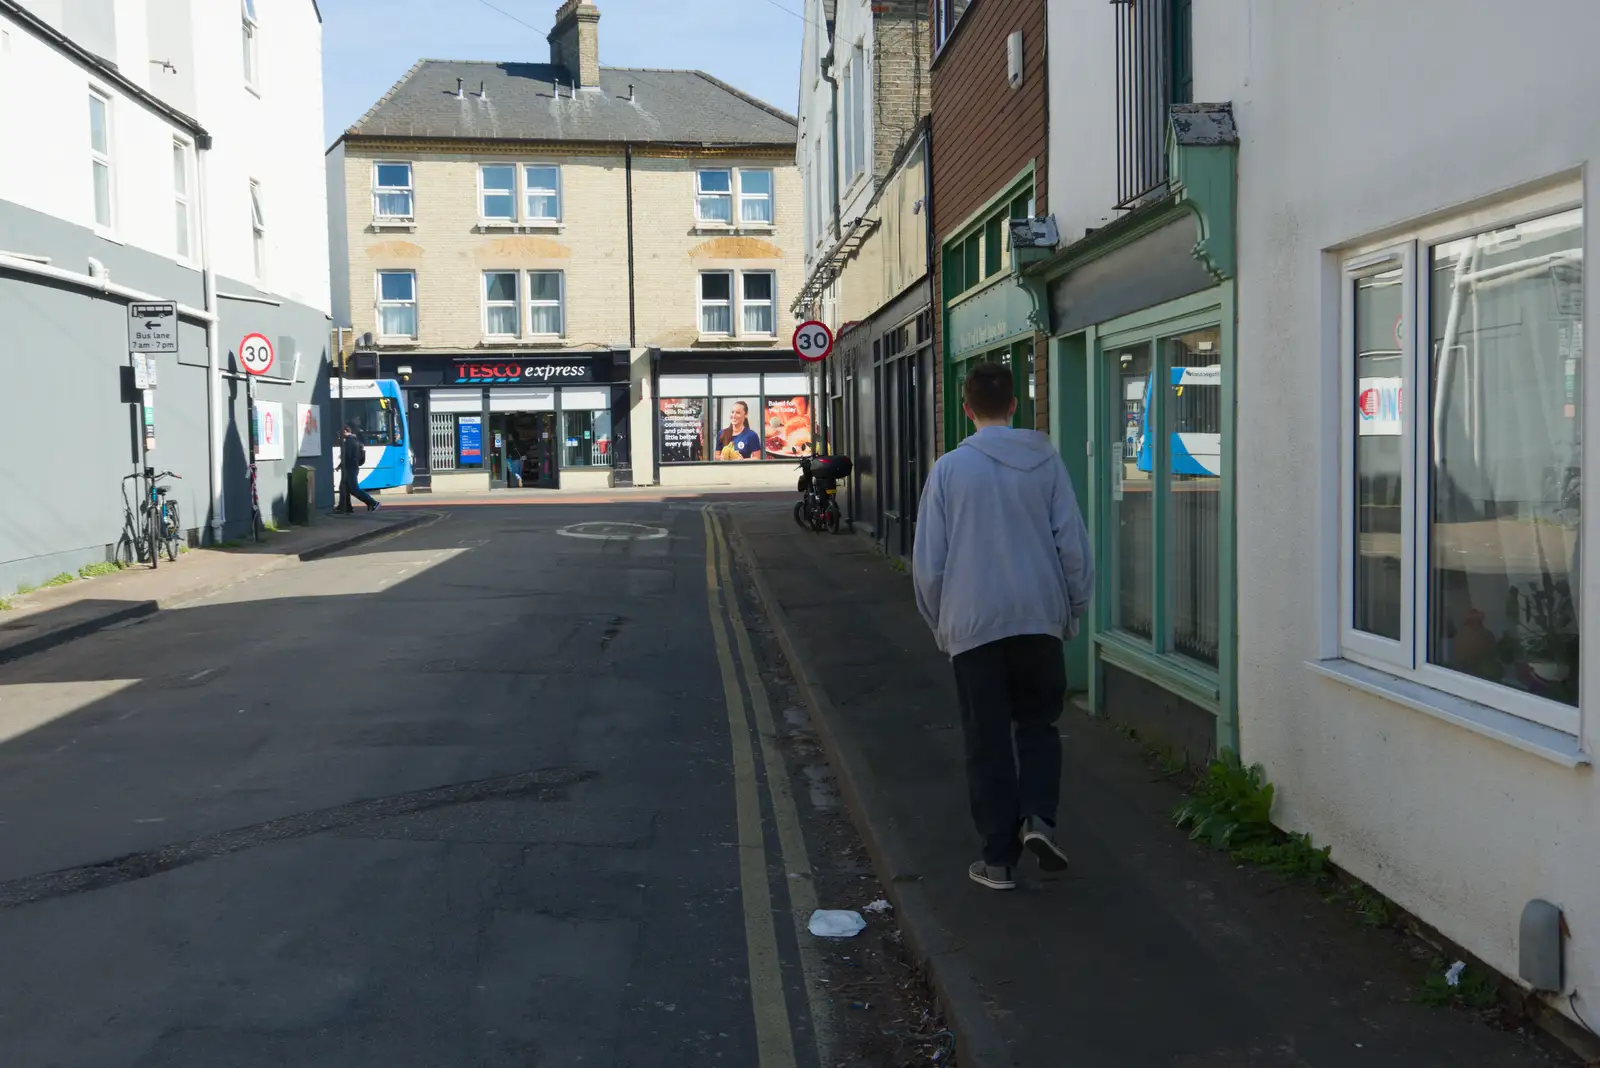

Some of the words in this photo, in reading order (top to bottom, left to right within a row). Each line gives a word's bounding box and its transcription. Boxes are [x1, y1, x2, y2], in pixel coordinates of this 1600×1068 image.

[153, 331, 170, 339] lane
[799, 332, 827, 350] 30
[245, 346, 268, 362] 30
[455, 363, 521, 378] TESCO
[525, 364, 584, 380] express
